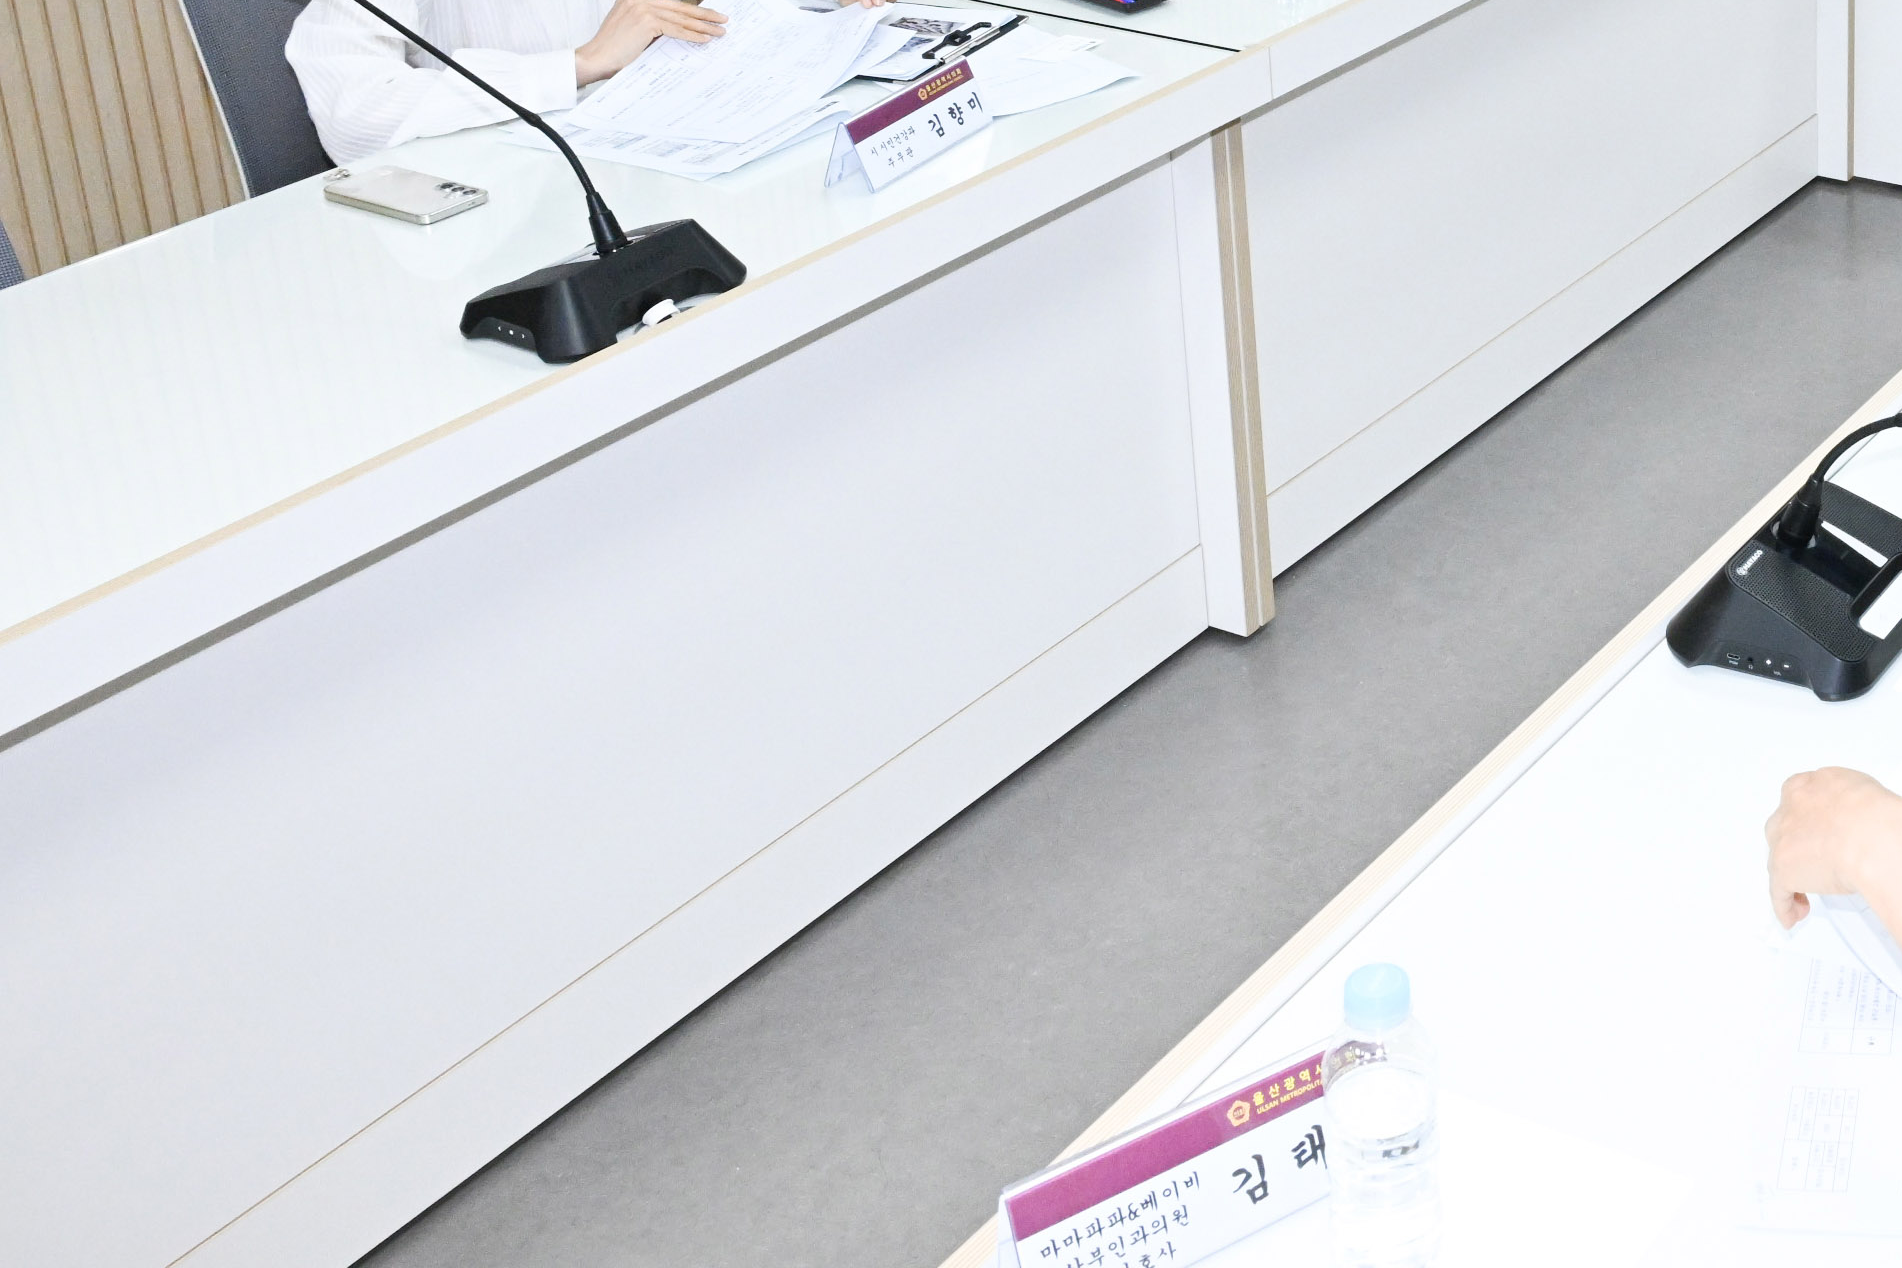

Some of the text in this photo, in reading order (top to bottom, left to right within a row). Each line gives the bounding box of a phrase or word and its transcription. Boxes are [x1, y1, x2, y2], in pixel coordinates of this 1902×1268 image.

[927, 91, 984, 138] 김향미
[1256, 1100, 1279, 1115] ULSAN
[1040, 1170, 1201, 1259] 마마파파&베이비
